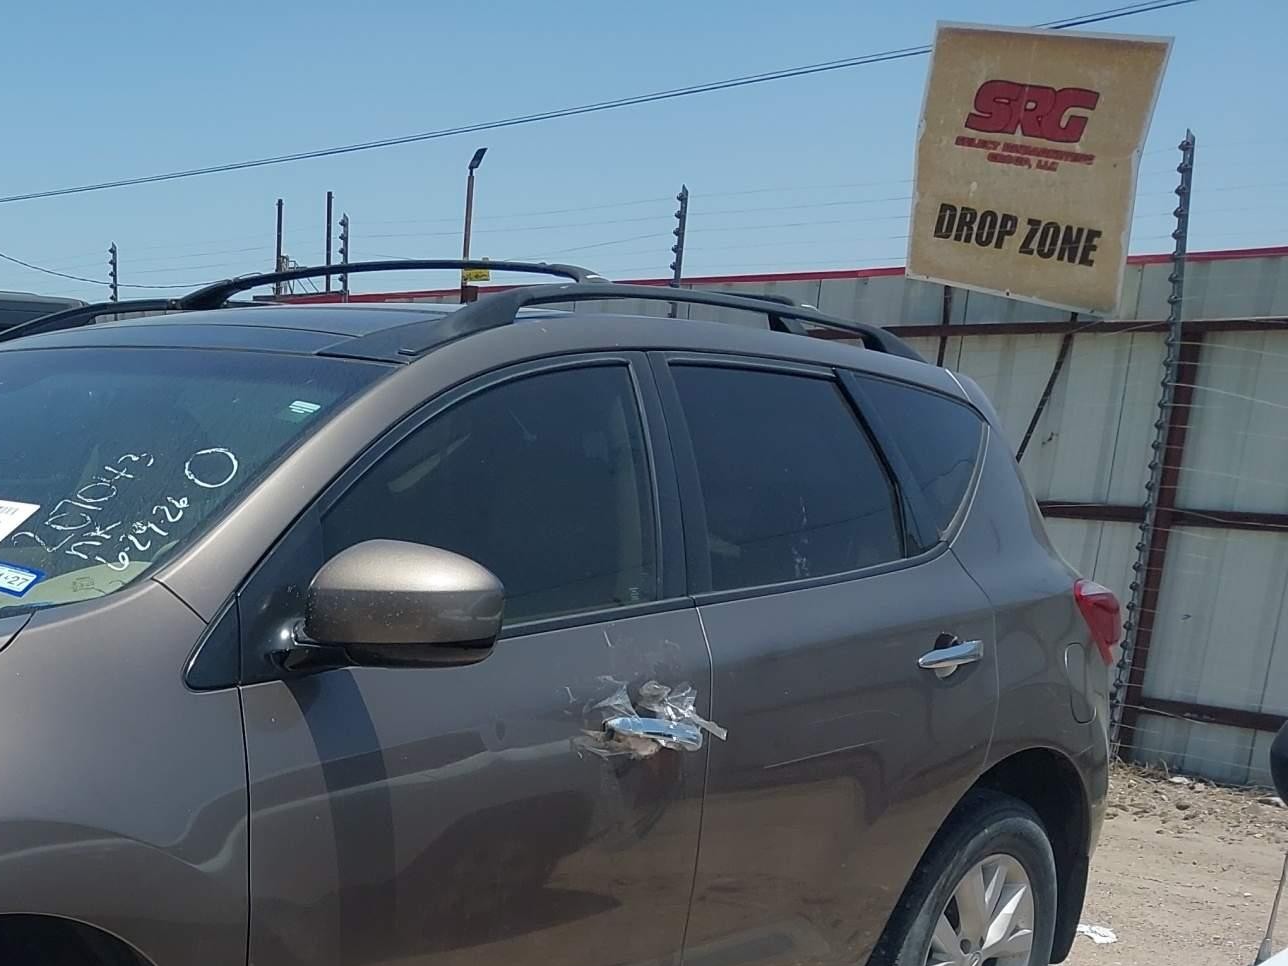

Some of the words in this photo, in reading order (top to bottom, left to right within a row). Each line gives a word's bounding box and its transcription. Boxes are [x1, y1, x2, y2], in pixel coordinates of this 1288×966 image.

[964, 79, 1100, 143] SRG
[934, 203, 1018, 249] DROP
[1018, 218, 1103, 267] ZONE
